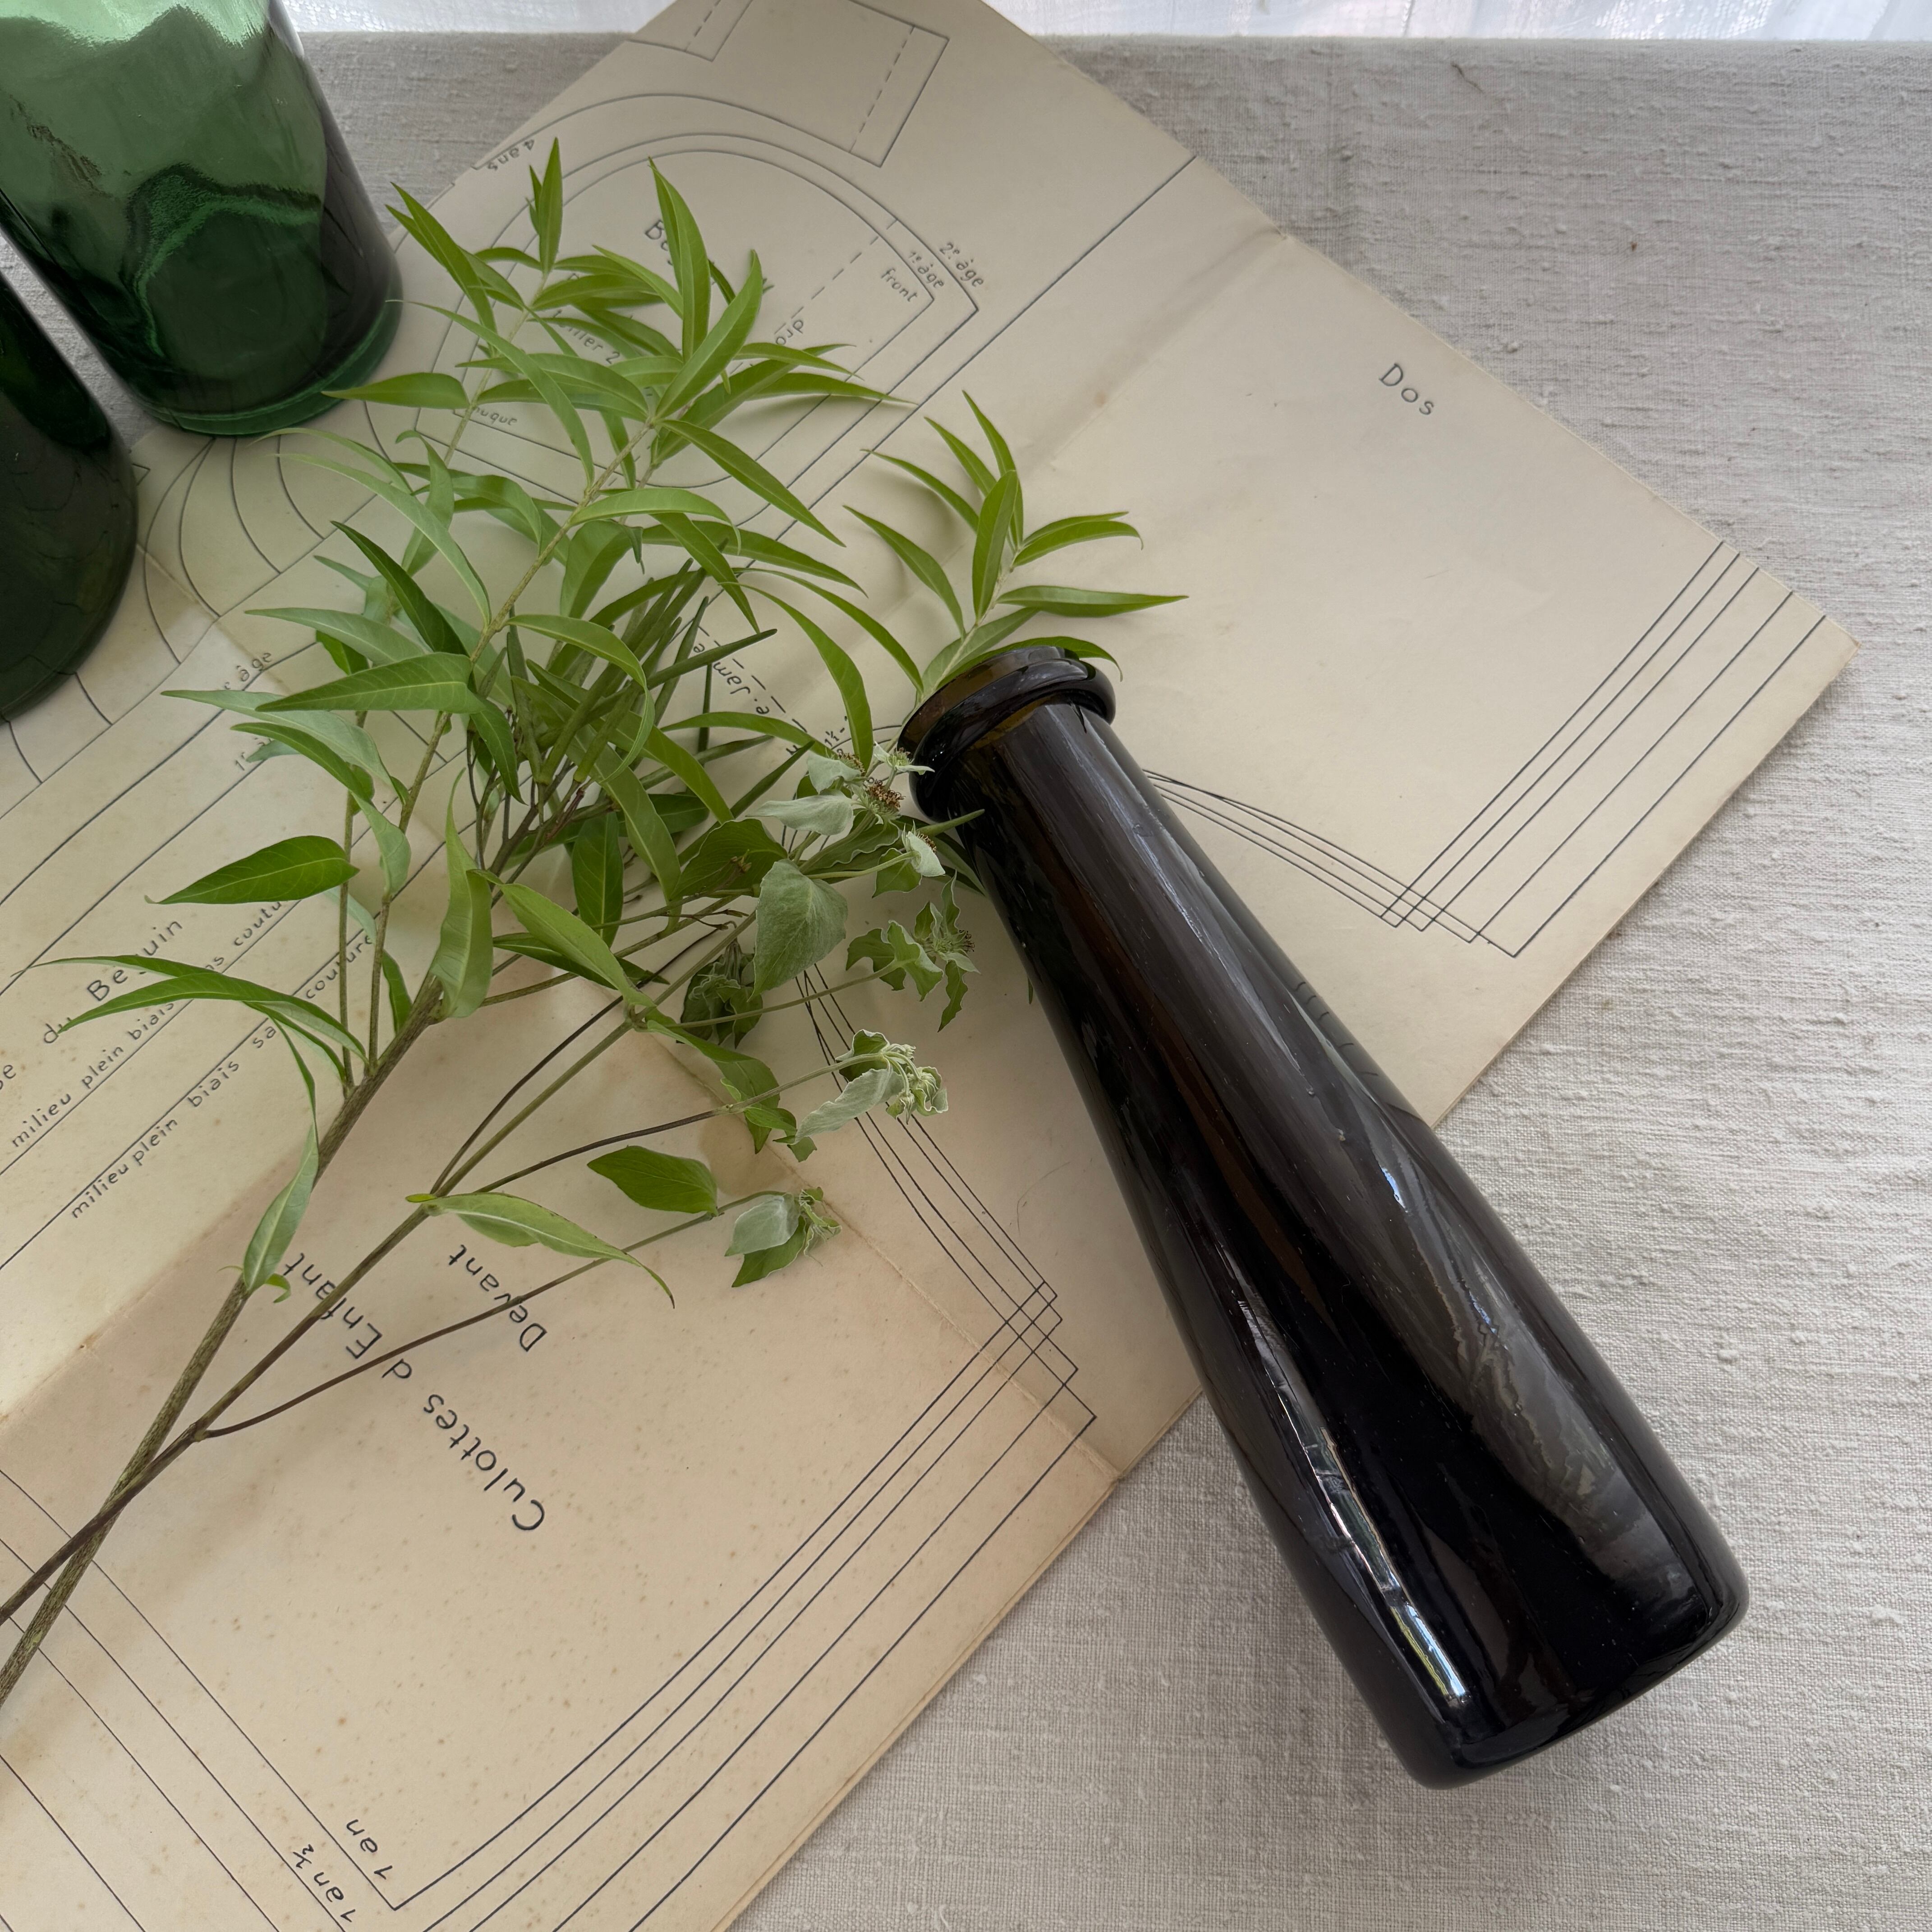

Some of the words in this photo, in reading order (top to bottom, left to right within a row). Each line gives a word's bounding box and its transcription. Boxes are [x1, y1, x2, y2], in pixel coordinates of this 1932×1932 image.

[488, 147, 520, 171] ans
[880, 267, 918, 302] front
[606, 350, 621, 365] 2
[1378, 362, 1435, 415] Dos
[236, 652, 272, 682] âge
[87, 921, 183, 1002] Beuin
[71, 1164, 130, 1219] milieu
[132, 1117, 179, 1167] plein
[187, 1060, 239, 1108] biais
[306, 935, 372, 999] couure
[12, 1093, 72, 1148] milieu
[81, 1045, 124, 1089] plein
[283, 1252, 383, 1359] Enfant
[448, 1244, 548, 1352] Devant
[423, 1394, 546, 1532] Culottes
[345, 1819, 378, 1854] an
[313, 1872, 344, 1903] an
[373, 1865, 393, 1880] 1
[340, 1909, 356, 1923] 1
